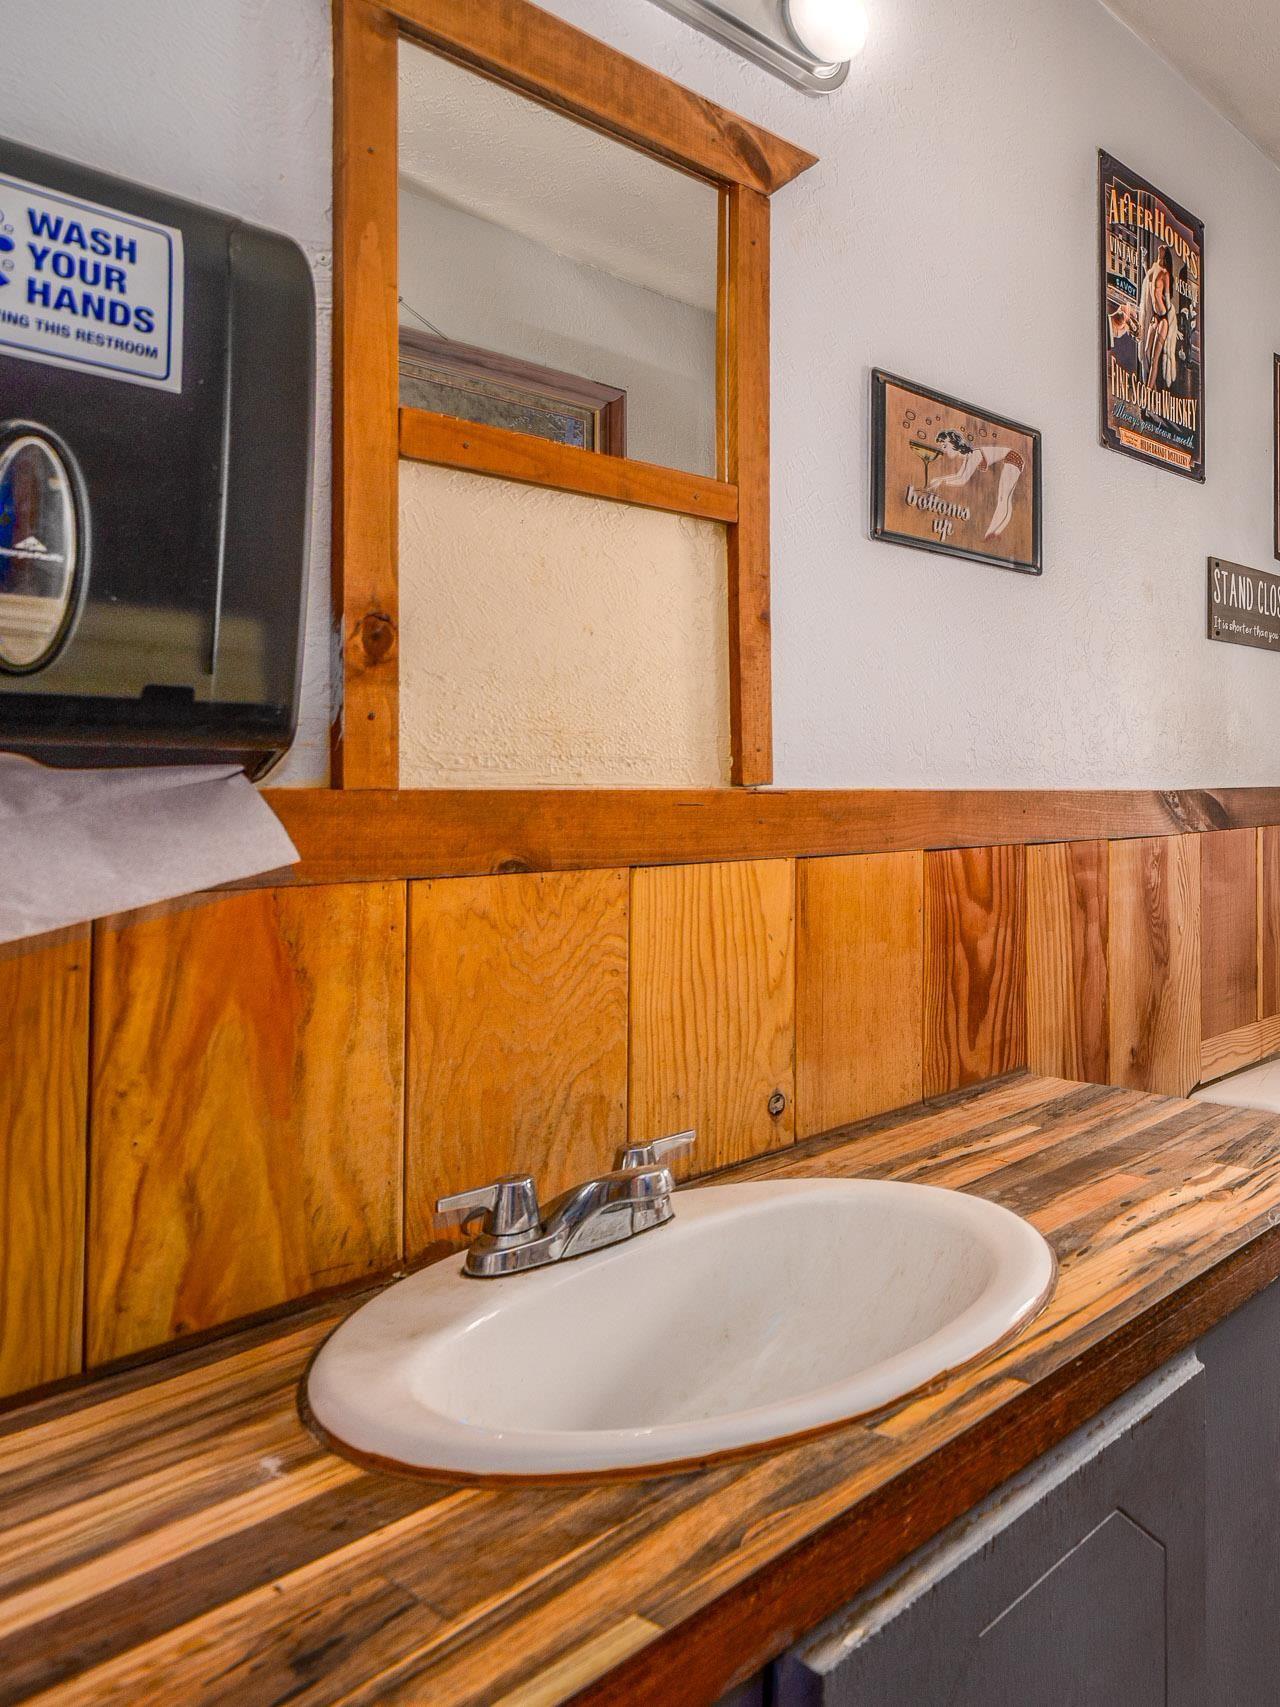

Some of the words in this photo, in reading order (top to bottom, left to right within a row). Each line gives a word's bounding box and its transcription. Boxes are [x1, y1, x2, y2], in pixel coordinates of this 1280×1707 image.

[27, 207, 138, 266] WASH
[1154, 207, 1198, 280] HOURS
[27, 242, 128, 295] YOUR
[26, 277, 156, 334] HANDS
[0, 309, 29, 328] ING
[35, 317, 71, 338] THIS
[76, 328, 160, 360] RESTROOM
[1111, 355, 1130, 403] FINE
[1131, 372, 1161, 417] SCOTCH
[1162, 389, 1198, 432] WHISKEY
[905, 485, 971, 521] bottoms
[932, 519, 955, 541] up
[1213, 568, 1254, 611] STAND
[1213, 615, 1221, 630] It
[1222, 619, 1229, 630] is
[1229, 620, 1252, 635] shorter
[1252, 625, 1269, 638] than
[1268, 631, 1279, 643] you
